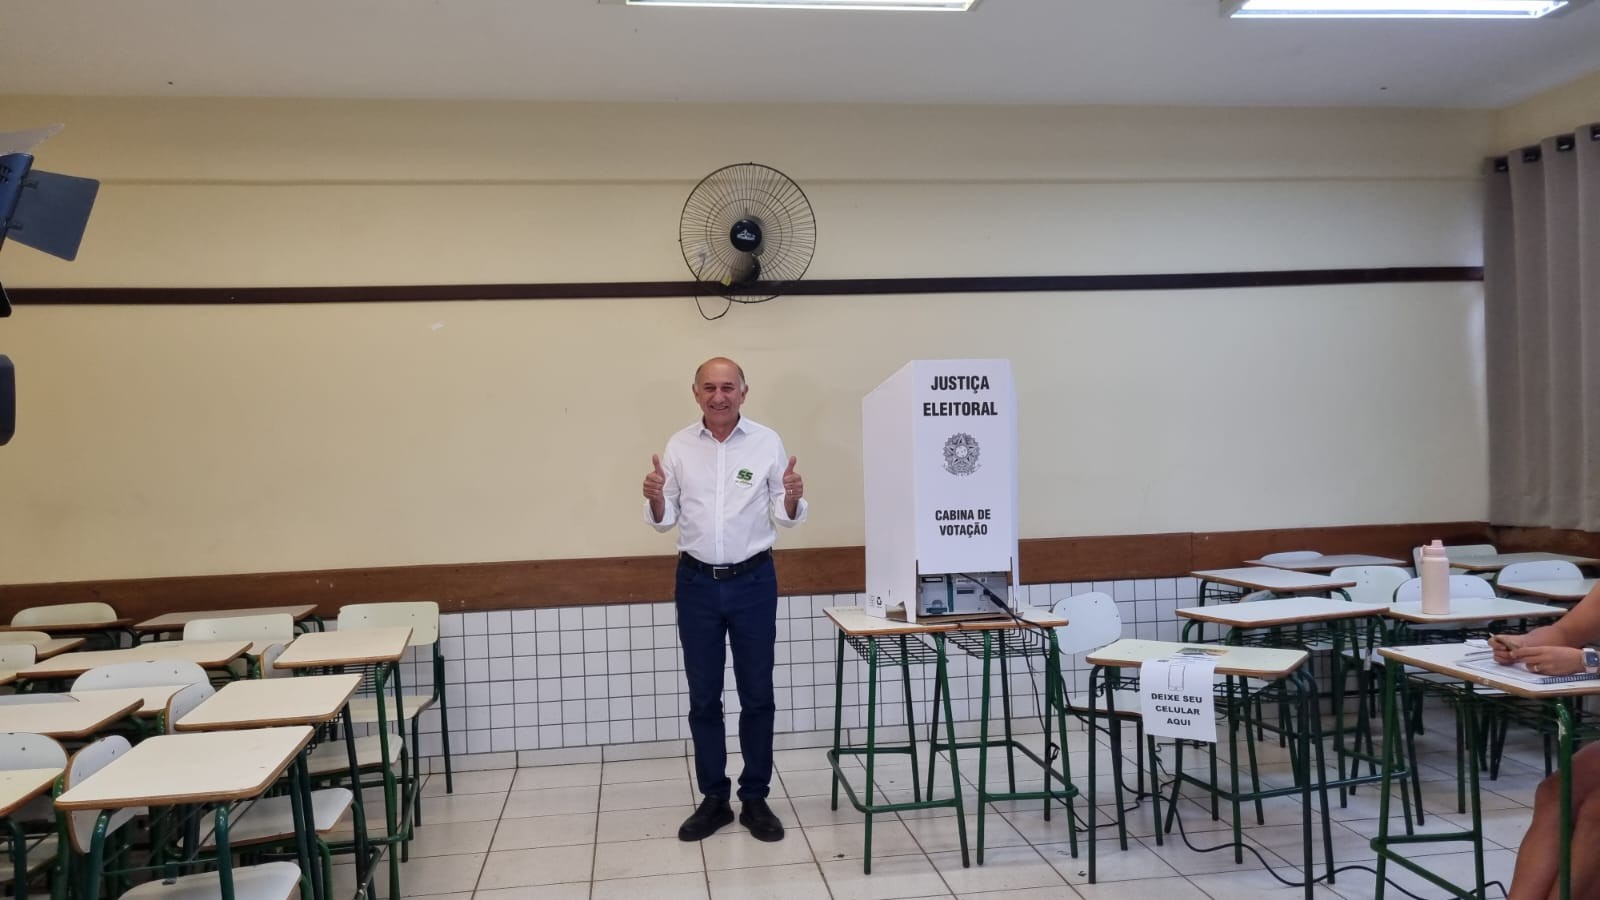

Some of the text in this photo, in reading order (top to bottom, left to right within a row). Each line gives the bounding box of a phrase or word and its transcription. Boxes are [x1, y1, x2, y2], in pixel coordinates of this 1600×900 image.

[930, 375, 990, 393] JUSTIÇA
[923, 402, 998, 417] ELEITORAL
[935, 509, 991, 521] CABINA DE
[939, 522, 988, 538] VOTAÇÃO
[1151, 693, 1202, 703] DEIXE SEU
[1155, 705, 1200, 715] CELULAR
[1167, 718, 1191, 726] AQUI
